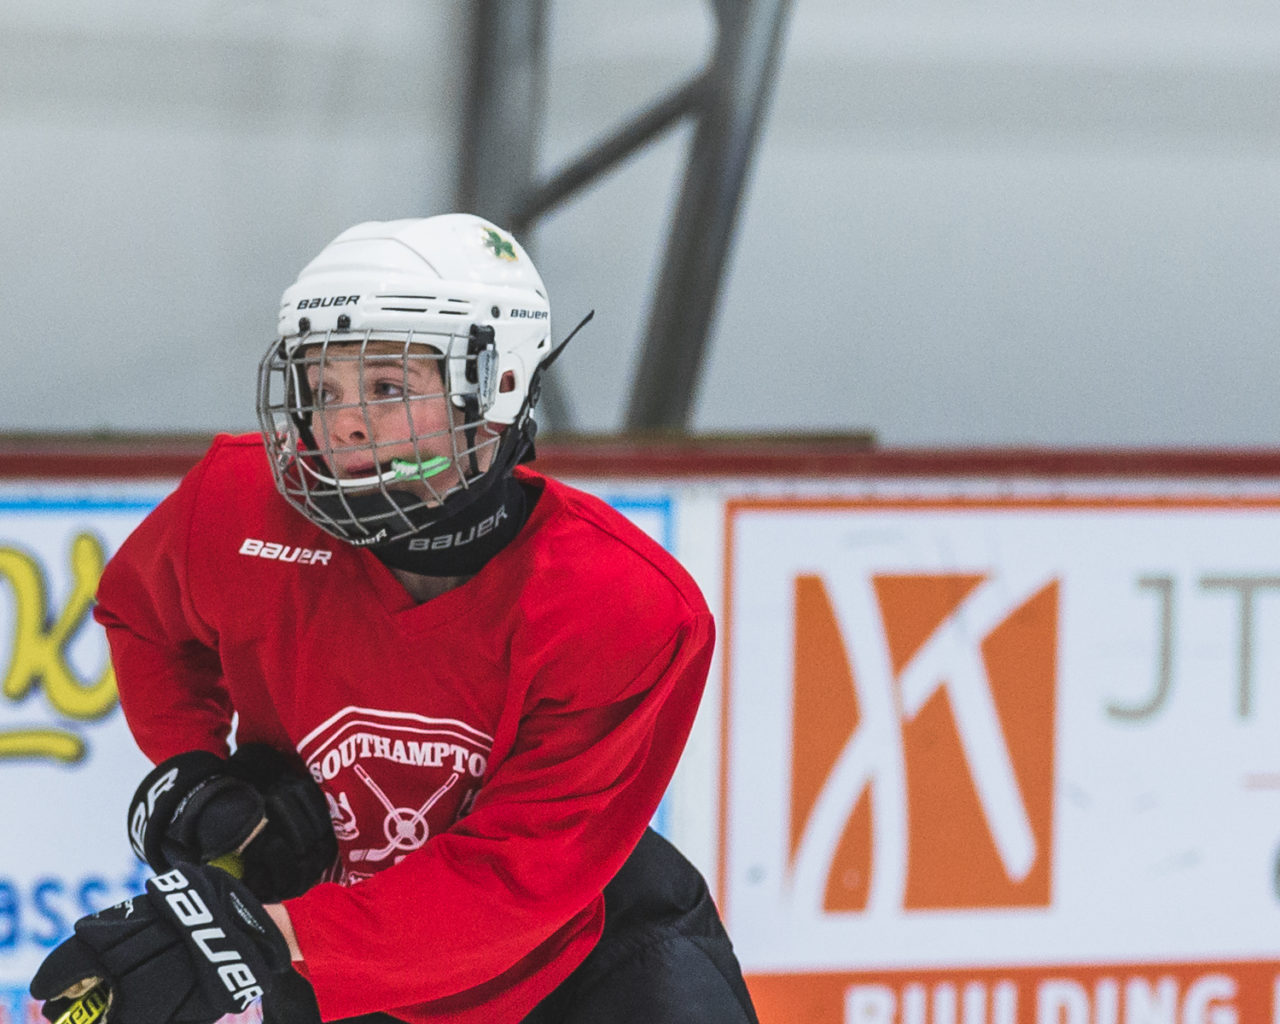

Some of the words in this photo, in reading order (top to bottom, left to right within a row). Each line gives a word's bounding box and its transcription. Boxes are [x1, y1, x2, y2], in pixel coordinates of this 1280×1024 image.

[297, 295, 360, 310] BAUER
[510, 309, 548, 319] BAUER
[408, 505, 508, 551] BAUER
[238, 538, 332, 565] BAUER
[150, 868, 264, 1010] BAUER
